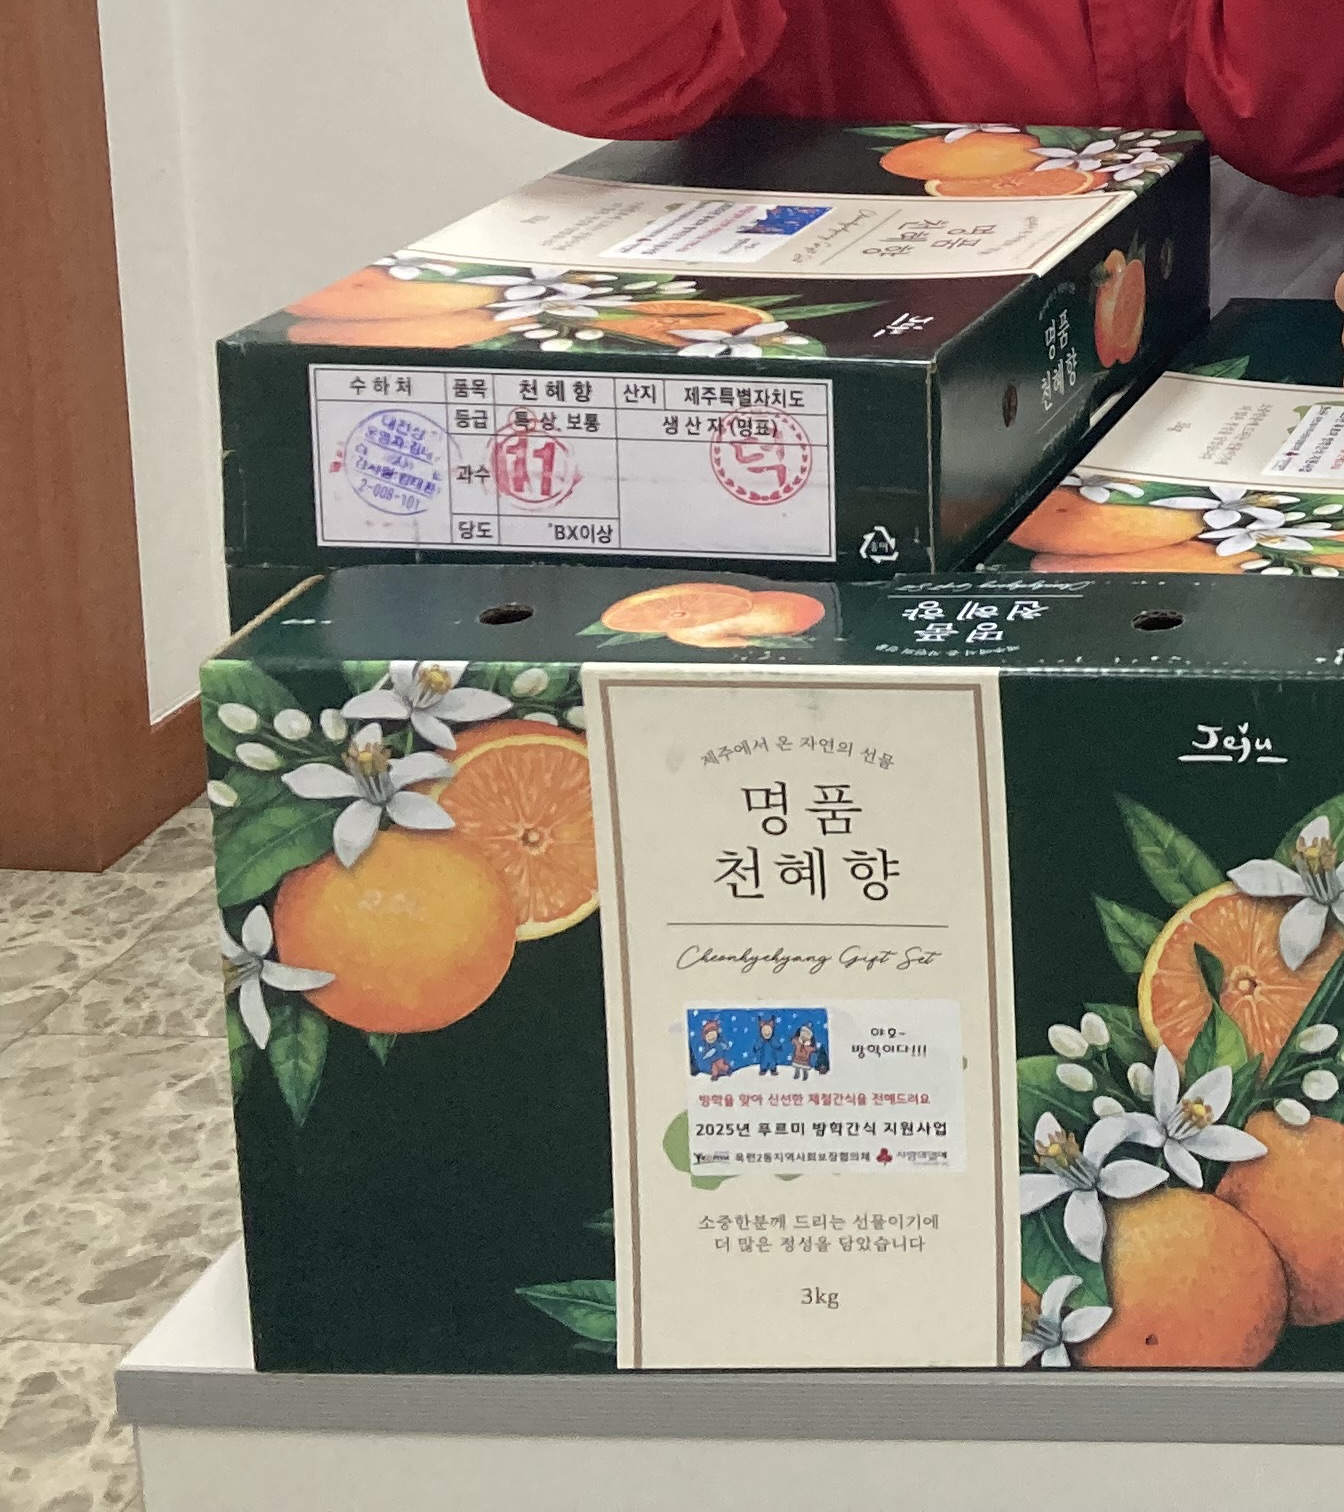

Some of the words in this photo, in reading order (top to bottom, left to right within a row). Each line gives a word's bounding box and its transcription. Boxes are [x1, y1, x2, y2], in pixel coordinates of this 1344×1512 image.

[452, 379, 487, 399] 품목
[518, 379, 593, 403] 천혜향
[623, 384, 657, 404] 산지
[684, 386, 805, 408] 제주특별자치도
[454, 409, 488, 430] 등급
[566, 412, 601, 432] 보통
[456, 464, 490, 484] 과수
[458, 520, 493, 540] 당도
[1191, 722, 1273, 763] Jeju
[740, 780, 863, 836] 명품
[712, 845, 901, 901] 천혜향
[695, 1120, 751, 1137] 2025년
[757, 1121, 806, 1137] 푸르미
[812, 1120, 877, 1137] 방학간식
[884, 1121, 948, 1138] 지원사업
[698, 1213, 787, 1232] 소중한분께
[793, 1213, 846, 1232] 드리는
[852, 1213, 940, 1232] 선물이기에
[715, 1236, 731, 1253] 더
[738, 1236, 773, 1254] 많은
[780, 1236, 832, 1253] 정성을
[838, 1236, 926, 1254] 담았습니다
[799, 1287, 840, 1309] 3kg
